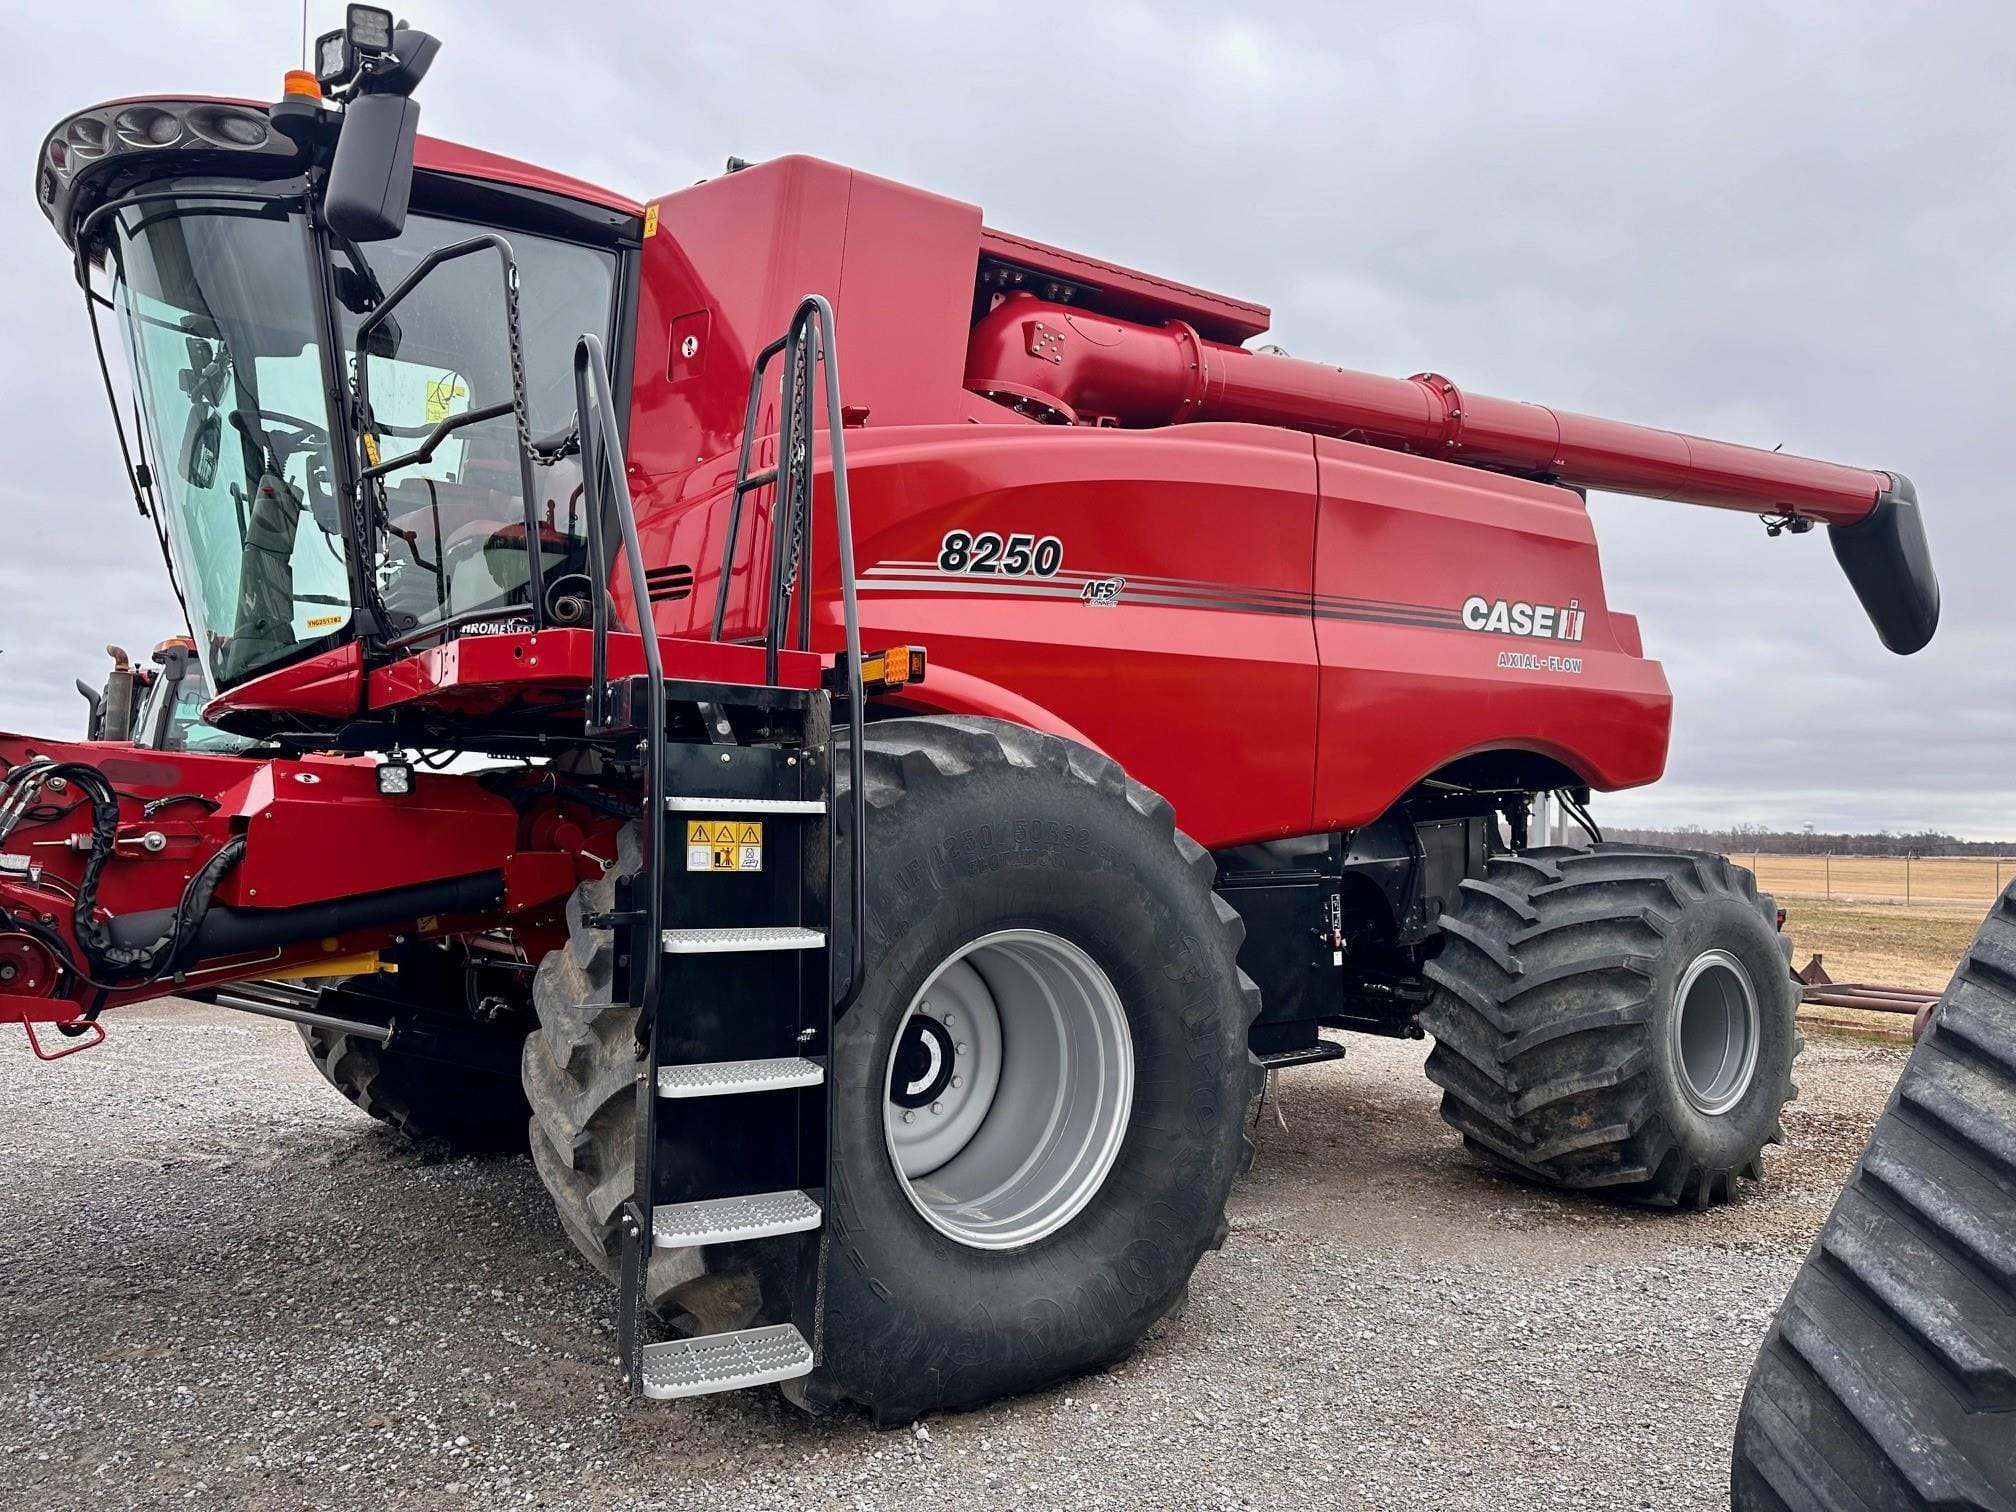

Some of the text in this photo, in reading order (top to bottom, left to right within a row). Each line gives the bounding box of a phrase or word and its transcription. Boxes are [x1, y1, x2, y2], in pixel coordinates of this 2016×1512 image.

[937, 529, 1062, 578] 8250
[1080, 580, 1116, 599] AFS
[1461, 595, 1555, 638] CASE
[1498, 652, 1582, 673] AXIAL-FLOW
